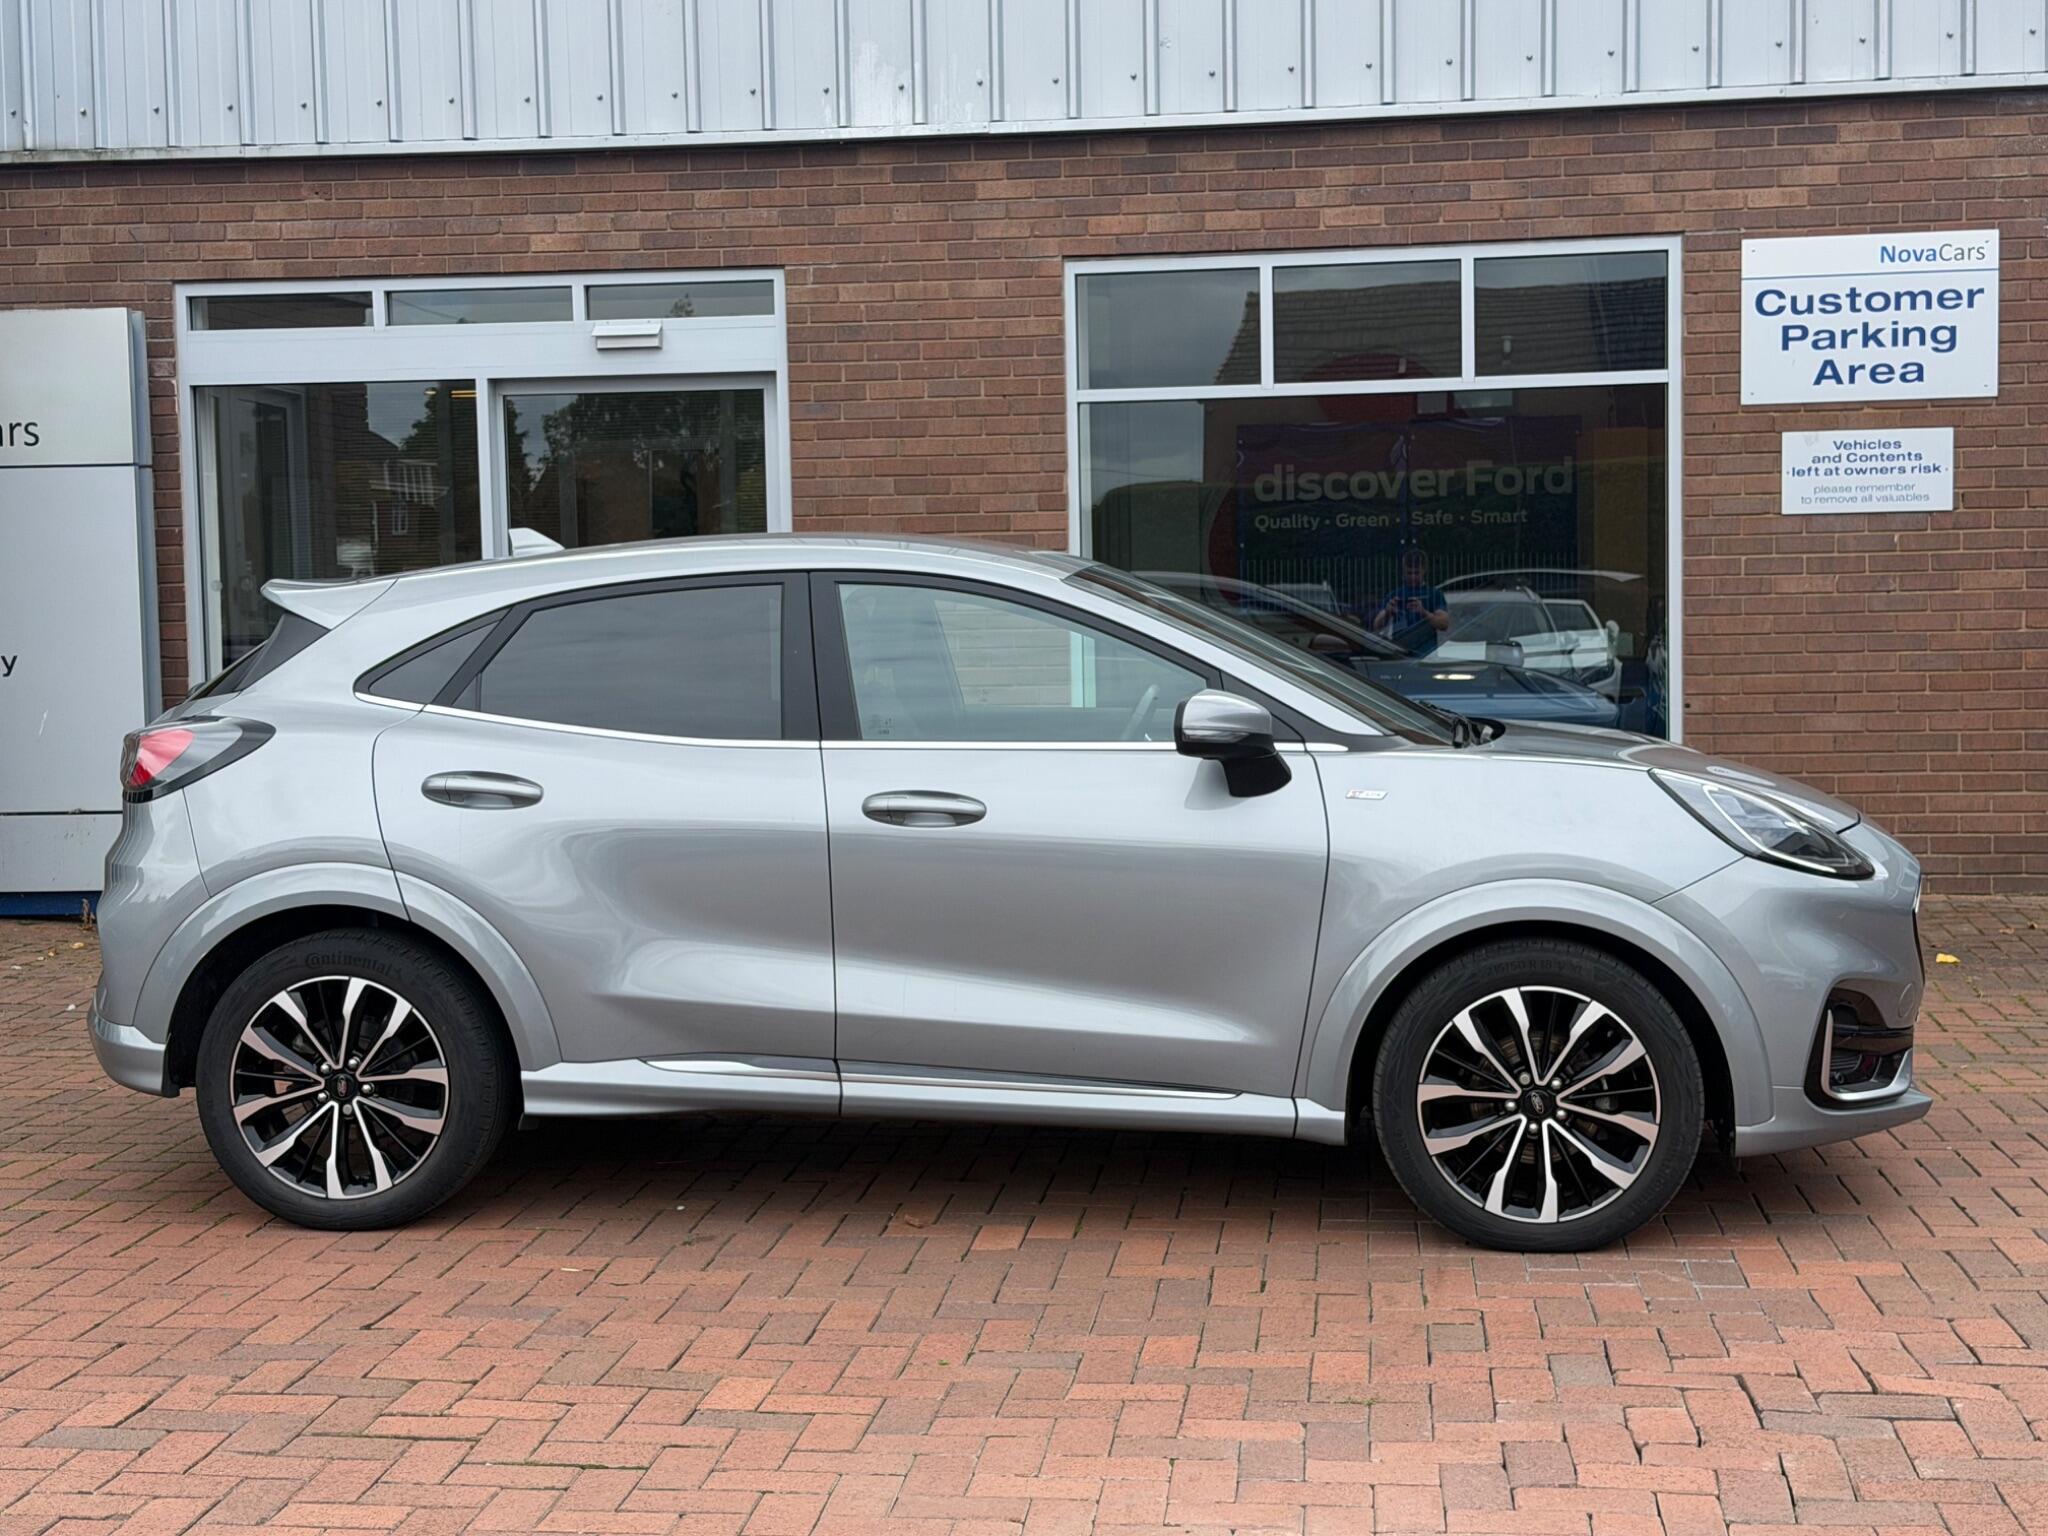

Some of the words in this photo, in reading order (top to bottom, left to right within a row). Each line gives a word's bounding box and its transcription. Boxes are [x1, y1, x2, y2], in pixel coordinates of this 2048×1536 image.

[1880, 243, 1986, 263] NovaCars
[1755, 287, 1985, 316] Customer
[1781, 320, 1957, 353] Parking
[1813, 359, 1925, 385] Area
[0, 422, 40, 447] rs
[1833, 439, 1902, 451] Vehicles
[1811, 452, 1842, 464] and
[1846, 451, 1923, 463] Contents
[1253, 463, 1455, 501] discover
[1466, 456, 1574, 497] Ford
[1792, 466, 1820, 477] left
[1824, 467, 1840, 476] at
[1844, 465, 1906, 476] owners
[1911, 463, 1942, 474] risk
[1801, 496, 1812, 504] to
[1815, 494, 1858, 504] remove
[1861, 494, 1873, 503] all
[1875, 492, 1930, 503] valuables
[1813, 484, 1852, 495] please
[1855, 483, 1916, 493] remember
[1254, 513, 1321, 532] Quality
[1335, 512, 1390, 528] Green
[1410, 509, 1454, 526] Safe
[1470, 508, 1529, 525] Smart
